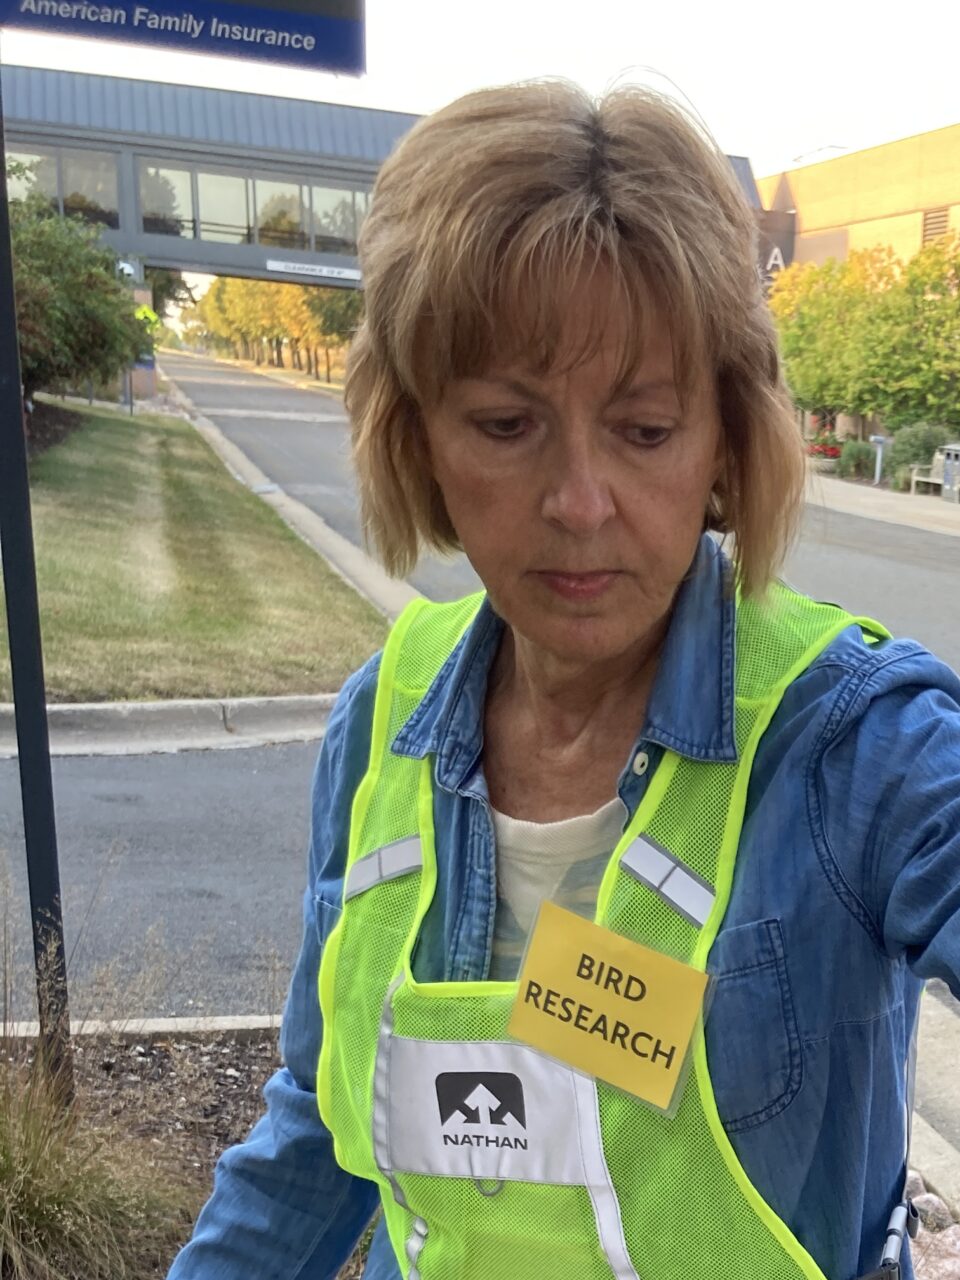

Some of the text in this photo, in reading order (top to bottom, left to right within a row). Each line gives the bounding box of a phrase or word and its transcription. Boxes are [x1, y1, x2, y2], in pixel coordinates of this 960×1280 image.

[20, 0, 316, 50] American Family Insurance
[766, 247, 785, 271] A
[576, 953, 647, 1002] BIRD
[524, 980, 676, 1069] RESEARCH
[443, 1134, 528, 1150] NATHAN
